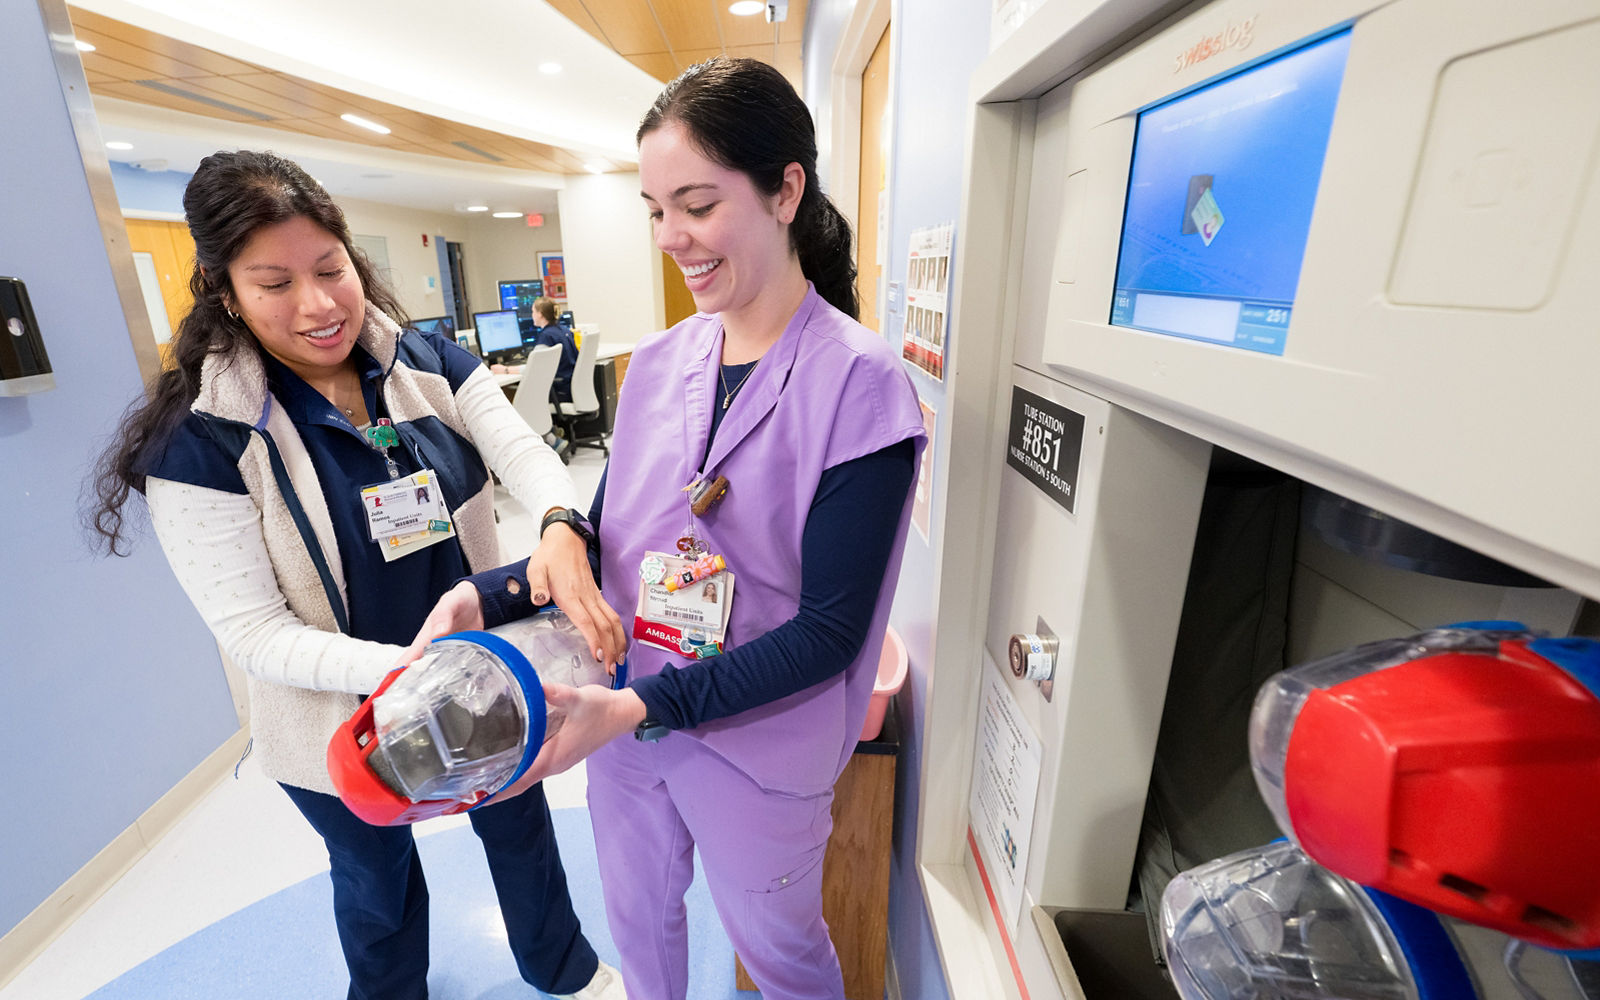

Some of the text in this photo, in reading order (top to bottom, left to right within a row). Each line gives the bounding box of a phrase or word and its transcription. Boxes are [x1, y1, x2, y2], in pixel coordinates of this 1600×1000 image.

[1173, 13, 1260, 74] swisslog
[1266, 308, 1288, 324] 251
[1024, 403, 1065, 435] TUBE STATION
[1010, 445, 1071, 496] NURSE STATION 5 SOUTH
[1022, 419, 1062, 471] #851
